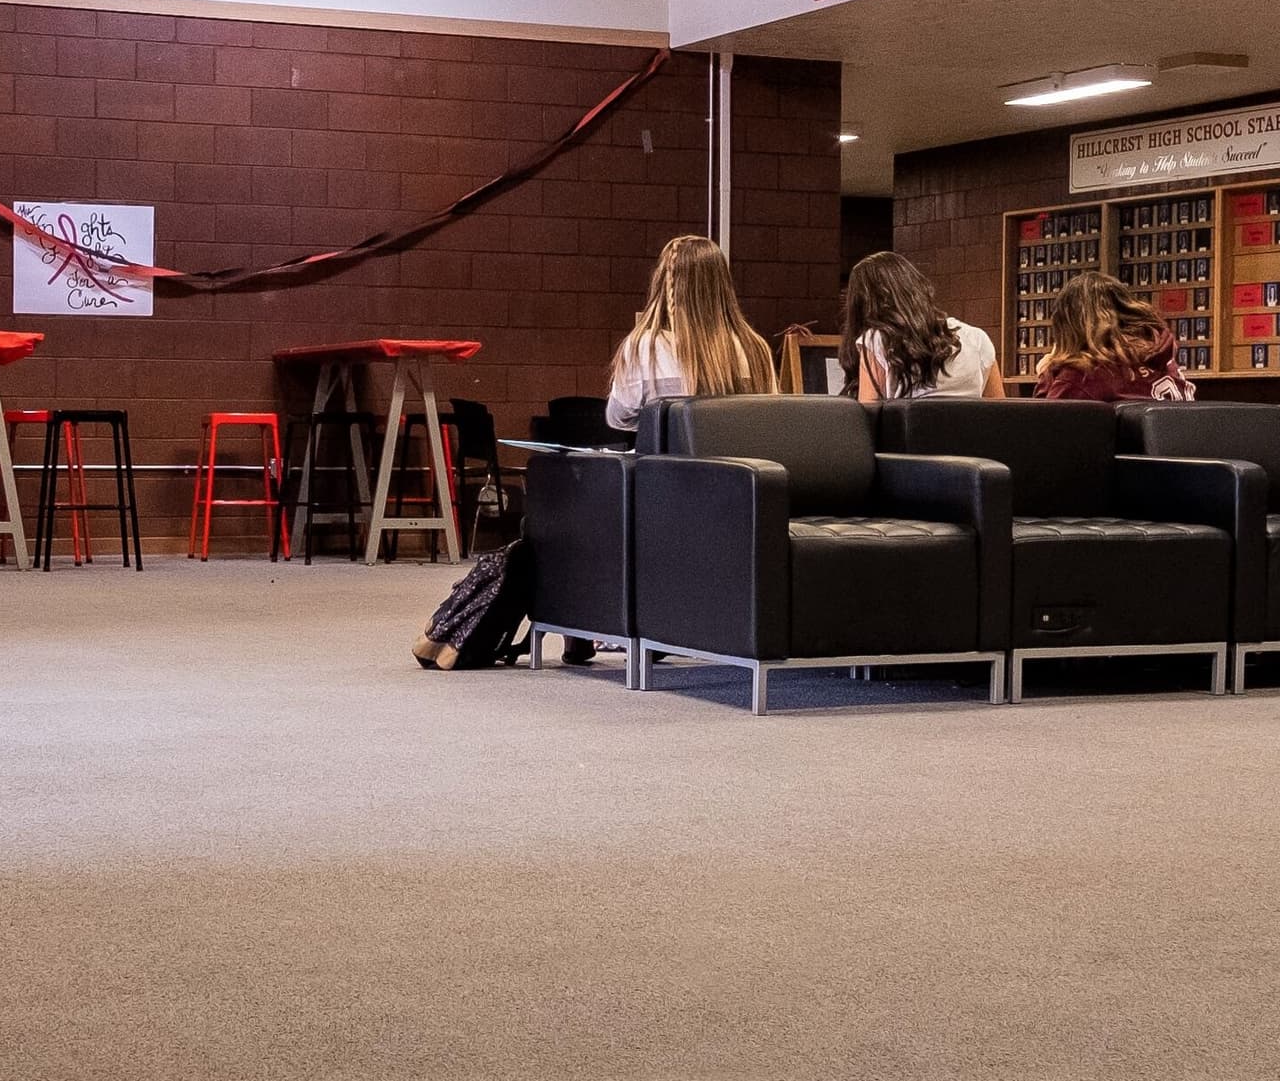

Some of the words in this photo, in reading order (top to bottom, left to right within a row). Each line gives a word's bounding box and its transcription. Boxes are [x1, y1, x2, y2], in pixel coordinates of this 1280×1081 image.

[1077, 135, 1144, 160] HILLCREST
[1148, 127, 1182, 150] HIGH
[1187, 119, 1243, 143] SCHOOL
[67, 288, 117, 309] Cure
